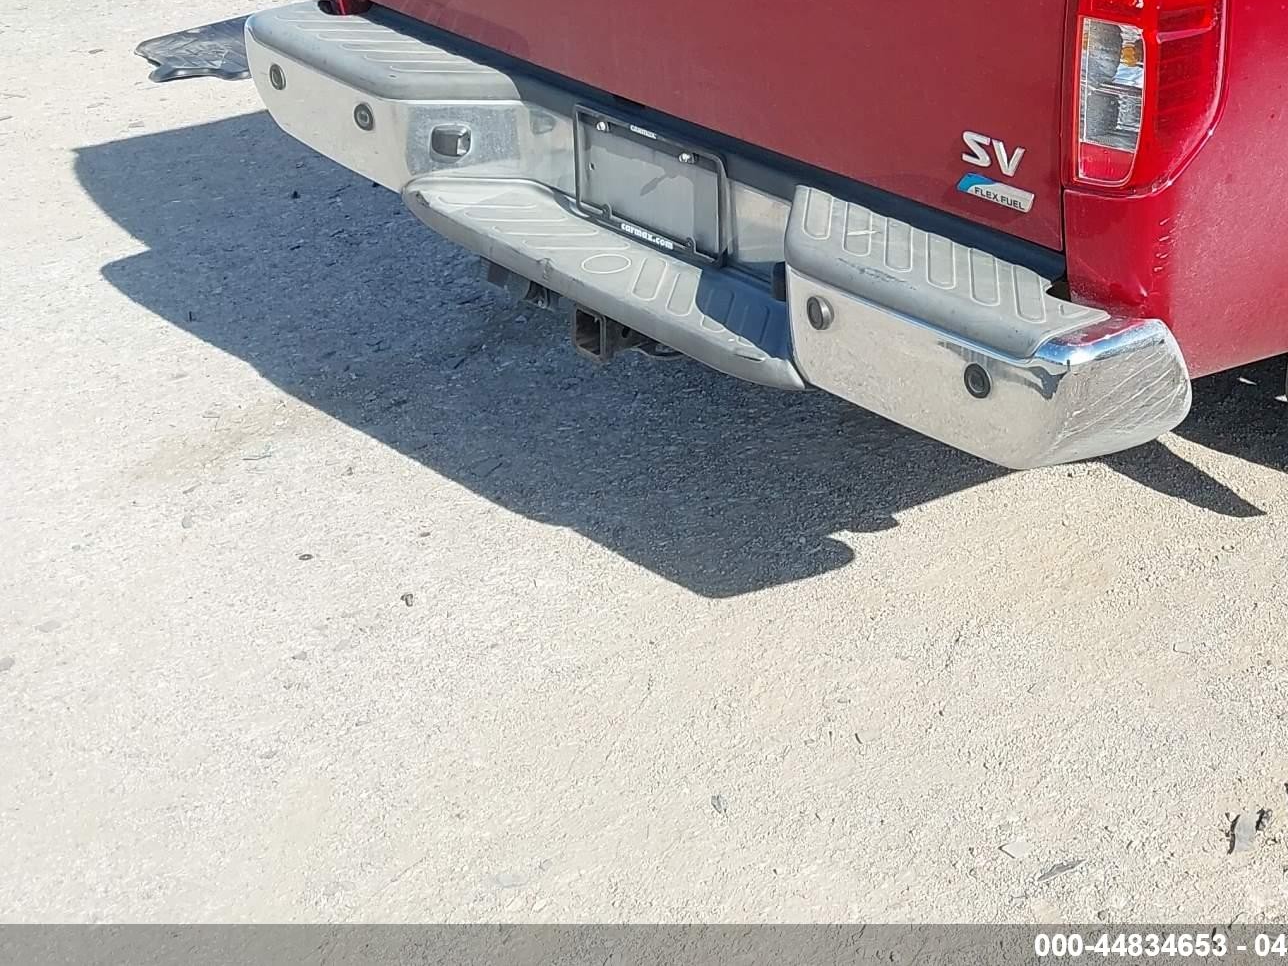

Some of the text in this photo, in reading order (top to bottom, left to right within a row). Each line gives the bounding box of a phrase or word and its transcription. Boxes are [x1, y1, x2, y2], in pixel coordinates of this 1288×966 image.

[961, 130, 1026, 177] SV
[974, 186, 1026, 211] FLEX FUEL
[621, 223, 674, 251] carmax.com
